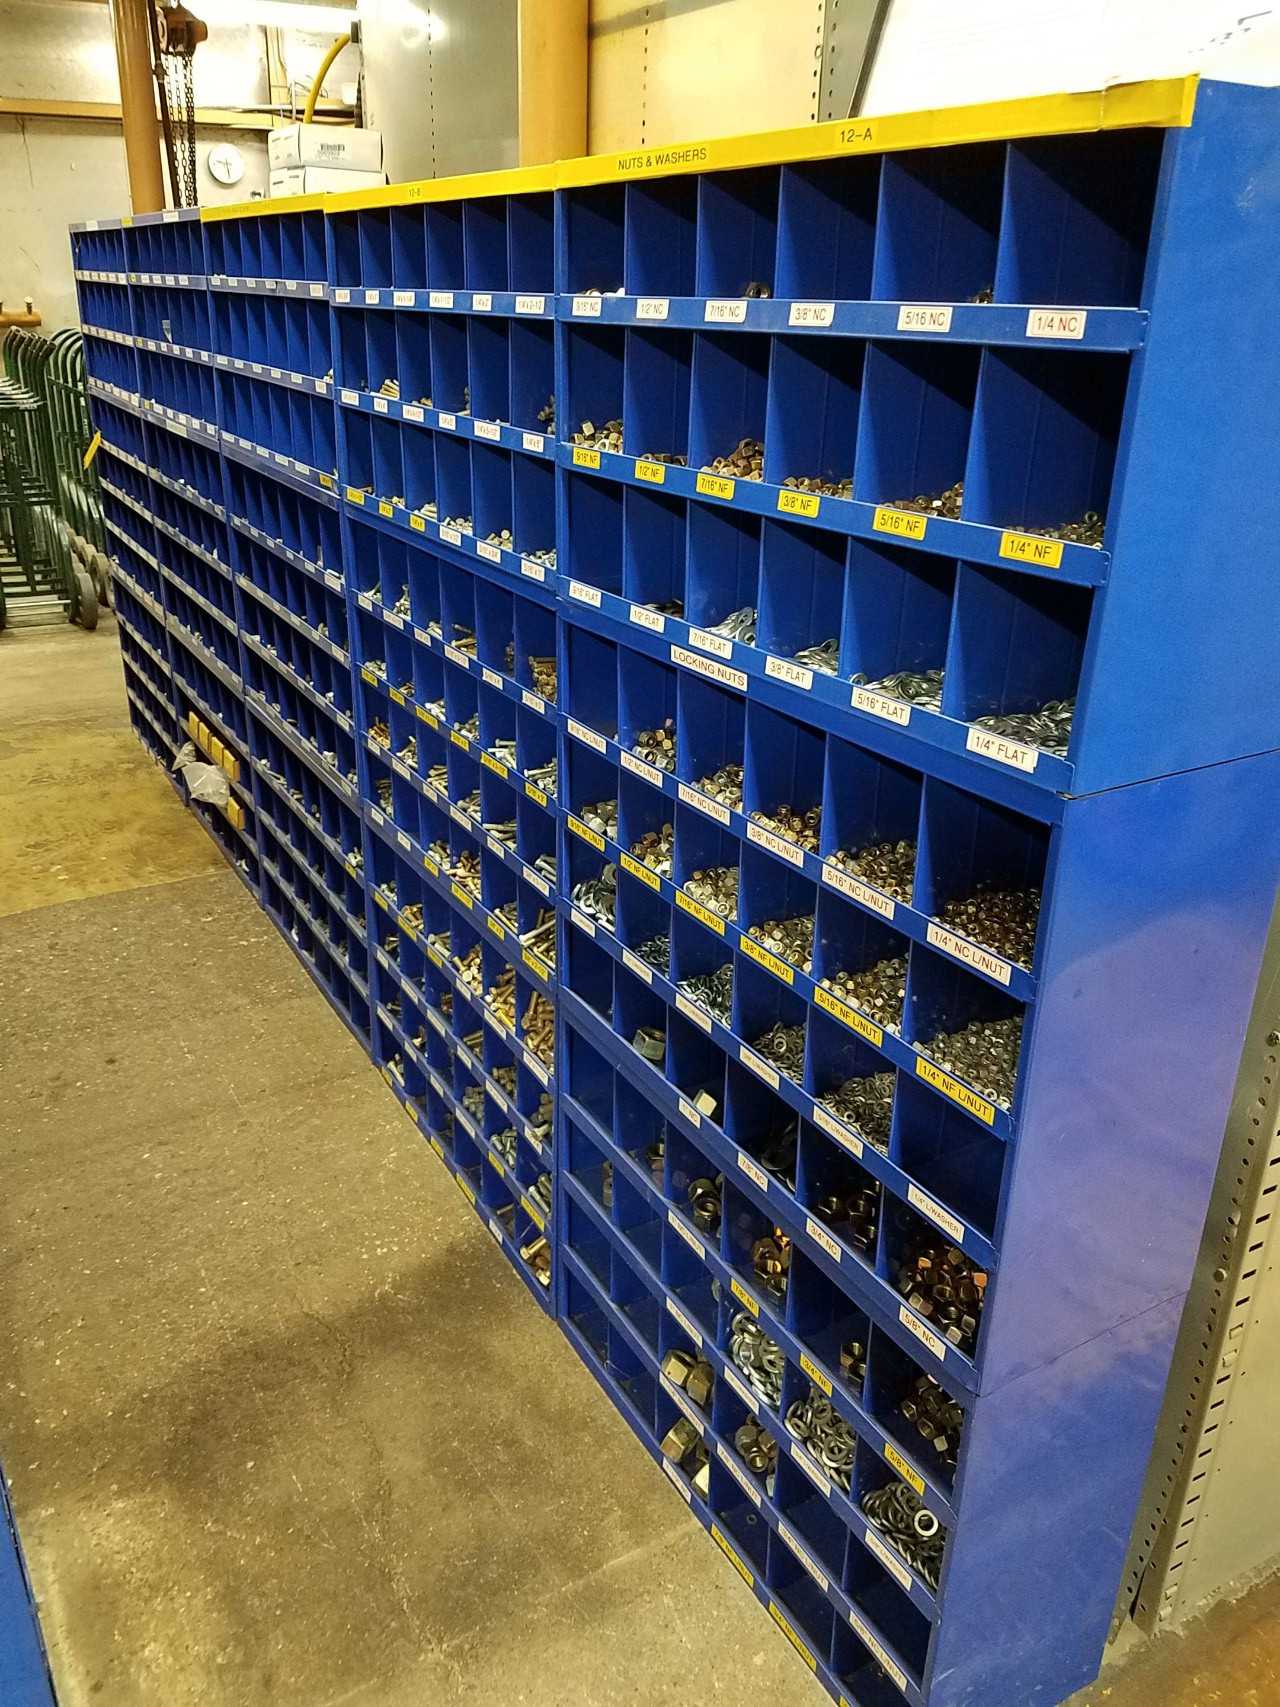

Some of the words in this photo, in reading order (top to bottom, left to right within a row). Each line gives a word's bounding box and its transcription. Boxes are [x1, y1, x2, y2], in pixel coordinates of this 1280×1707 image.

[840, 127, 873, 143] 12-A
[618, 156, 644, 171] NUTS
[646, 155, 652, 168] &
[655, 148, 708, 165] WASHERS
[653, 303, 664, 314] NC
[728, 305, 740, 317] NC
[812, 307, 826, 321] NC
[905, 311, 926, 326] 5/16
[928, 312, 945, 326] NC
[1036, 316, 1054, 331] 1/4
[1058, 317, 1077, 332] NC
[590, 453, 598, 466] NF
[651, 465, 660, 478] NF
[700, 475, 717, 491] 7/16"
[718, 479, 728, 494] NF
[783, 494, 799, 508] 3/8"
[800, 497, 812, 512] NF
[880, 513, 903, 530] 5/16"
[905, 518, 920, 533] NF
[1008, 539, 1031, 554] 1/4"
[1033, 543, 1052, 560] NF
[585, 590, 598, 602] FLAT
[644, 613, 660, 627] FLAT
[709, 636, 727, 653] FLAT
[673, 650, 715, 676] LOCKING
[716, 666, 745, 687] NUTS
[769, 660, 785, 675] 3/8"
[785, 666, 806, 684] FLAT
[857, 693, 880, 709] 5/16"
[880, 702, 905, 721] FLAT
[975, 735, 996, 752] 1/4"
[997, 745, 1028, 764] FLAT
[697, 796, 709, 811] NC
[751, 827, 766, 841] 3/8"
[766, 834, 779, 849] NC
[779, 841, 800, 862] L/NUT
[633, 863, 641, 874] NF
[827, 870, 847, 888] 5/16"
[848, 880, 861, 897] NC
[862, 890, 889, 911] L/NUT
[694, 904, 703, 918] NF
[934, 929, 952, 948] 1/4"
[954, 942, 970, 959] NC
[971, 950, 1006, 976] L/NUT
[757, 948, 768, 963] NF
[768, 956, 791, 978] L/NUT
[817, 991, 838, 1011] 5/16"
[839, 1006, 851, 1021] NF
[852, 1017, 879, 1040] L/NUT
[922, 1064, 940, 1081] 1/4"
[942, 1077, 957, 1094] NF
[958, 1089, 990, 1116] L/NUT
[754, 1169, 765, 1185] NC
[825, 1238, 837, 1256] NC
[904, 1313, 921, 1331] 5/8"
[921, 1331, 936, 1348] NC
[819, 1374, 828, 1388] NF
[906, 1467, 919, 1484] NF
